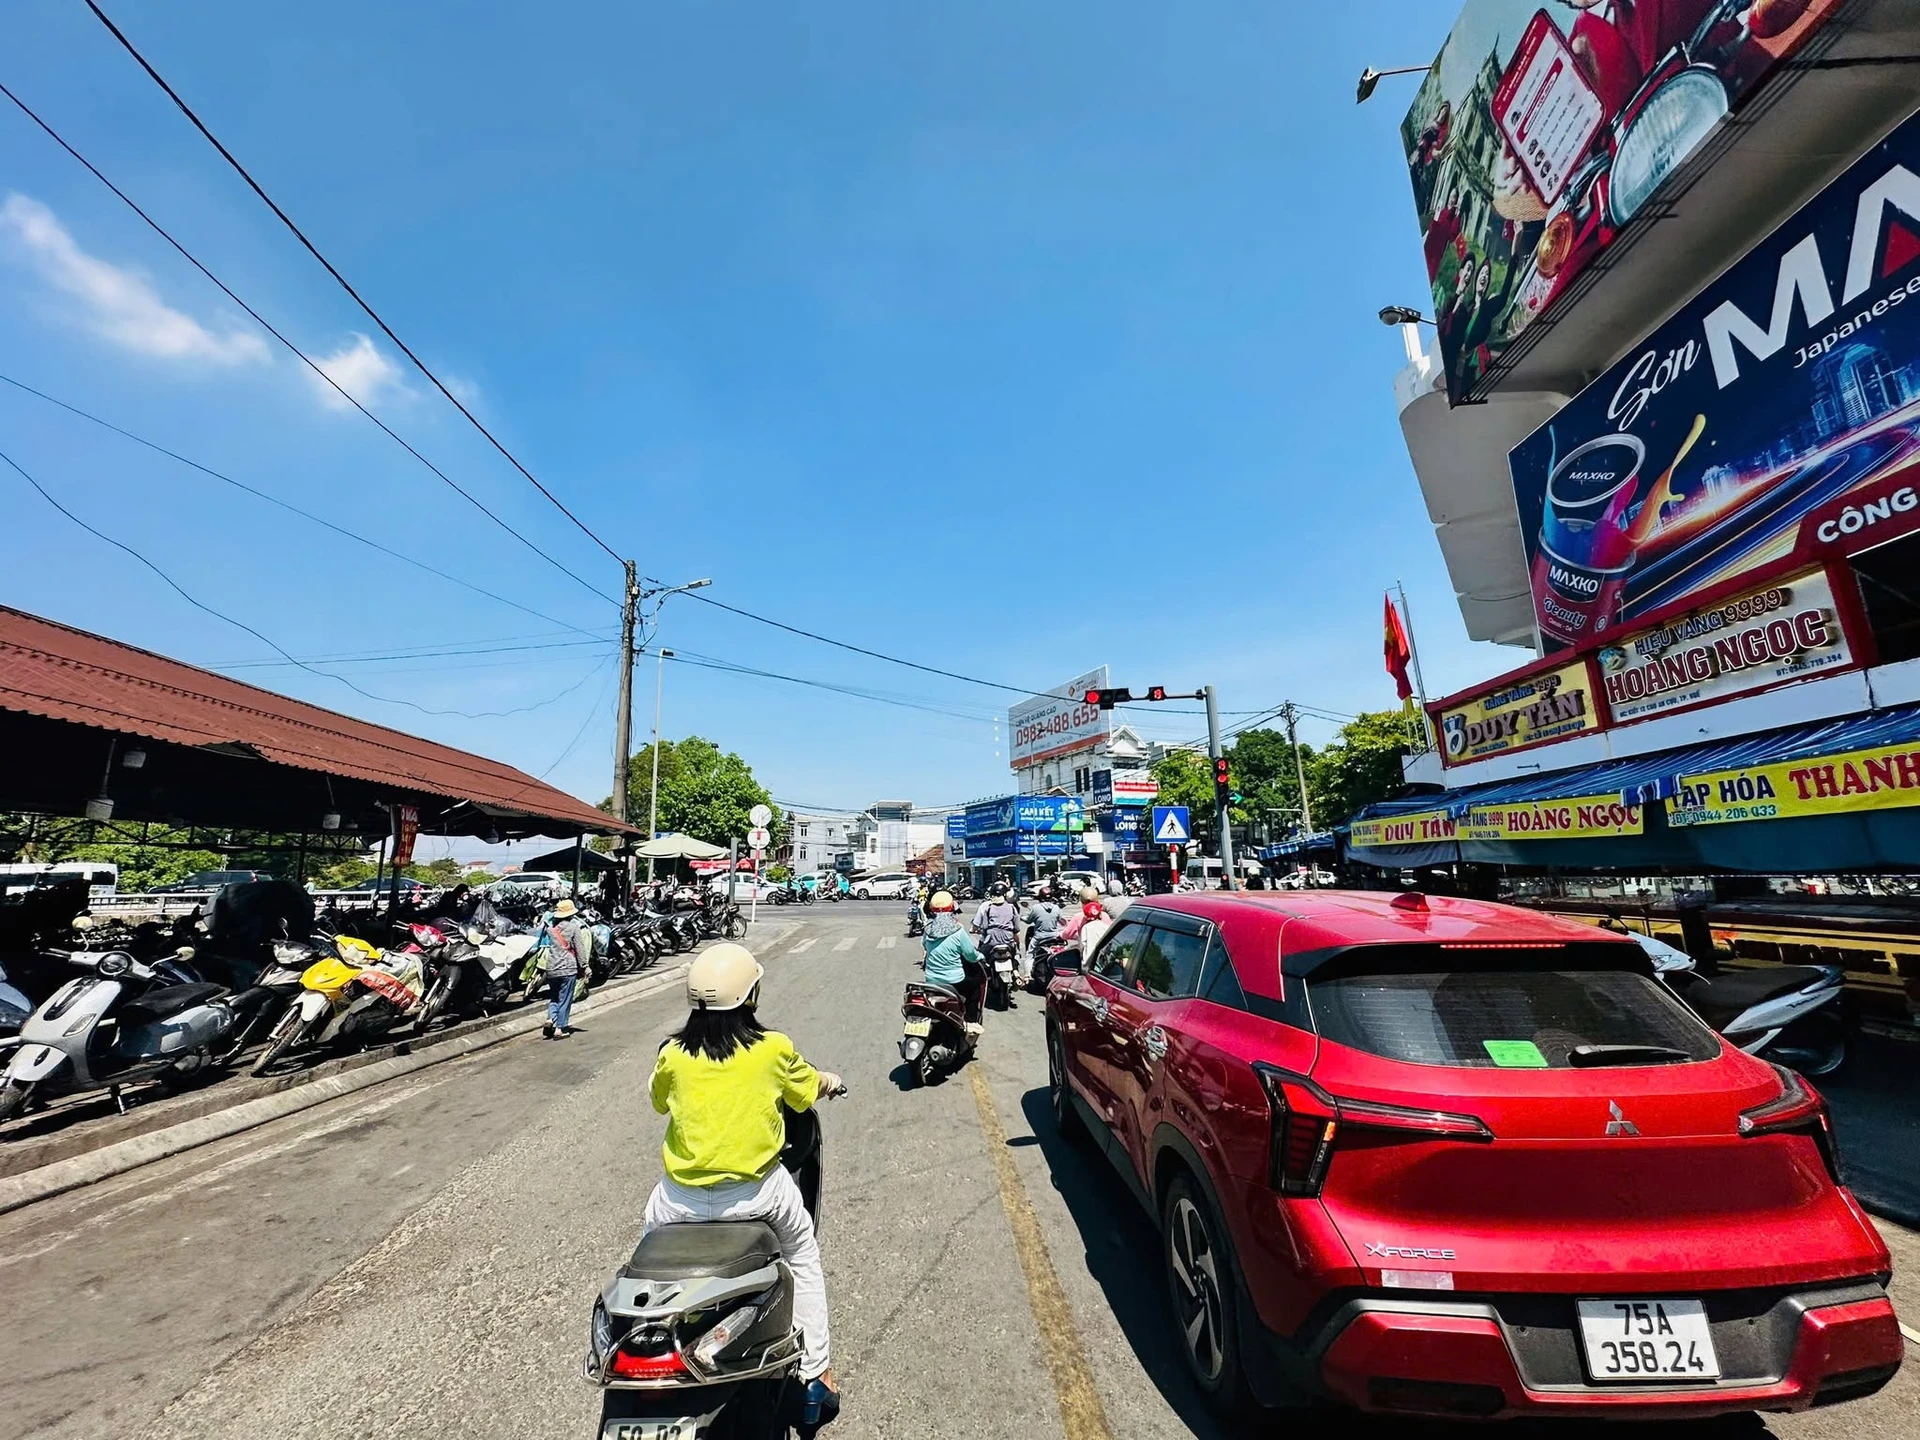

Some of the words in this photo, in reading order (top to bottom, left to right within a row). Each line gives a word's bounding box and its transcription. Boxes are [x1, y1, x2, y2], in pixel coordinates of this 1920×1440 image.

[1793, 275, 1920, 369] Japanese
[1607, 339, 1701, 432] Sơn
[1817, 486, 1918, 543] CÔNG
[1549, 565, 1598, 593] MAXKO
[1543, 595, 1587, 630] Beauty
[1633, 629, 1672, 655] HIỆU
[1724, 588, 1783, 623] 9999
[1603, 646, 1712, 705] HOÀNG
[1713, 609, 1829, 665] NGỌC
[1466, 711, 1516, 745] DUY
[1719, 772, 1776, 804] HÓA
[1507, 804, 1572, 832] HOÀNG
[1576, 802, 1640, 833] NGỌC
[1725, 806, 1747, 820] 206
[1385, 821, 1414, 841] DUY
[1364, 1241, 1457, 1260] XFORCE
[1614, 1303, 1674, 1335] 75A
[1601, 1340, 1705, 1373] 358.24
